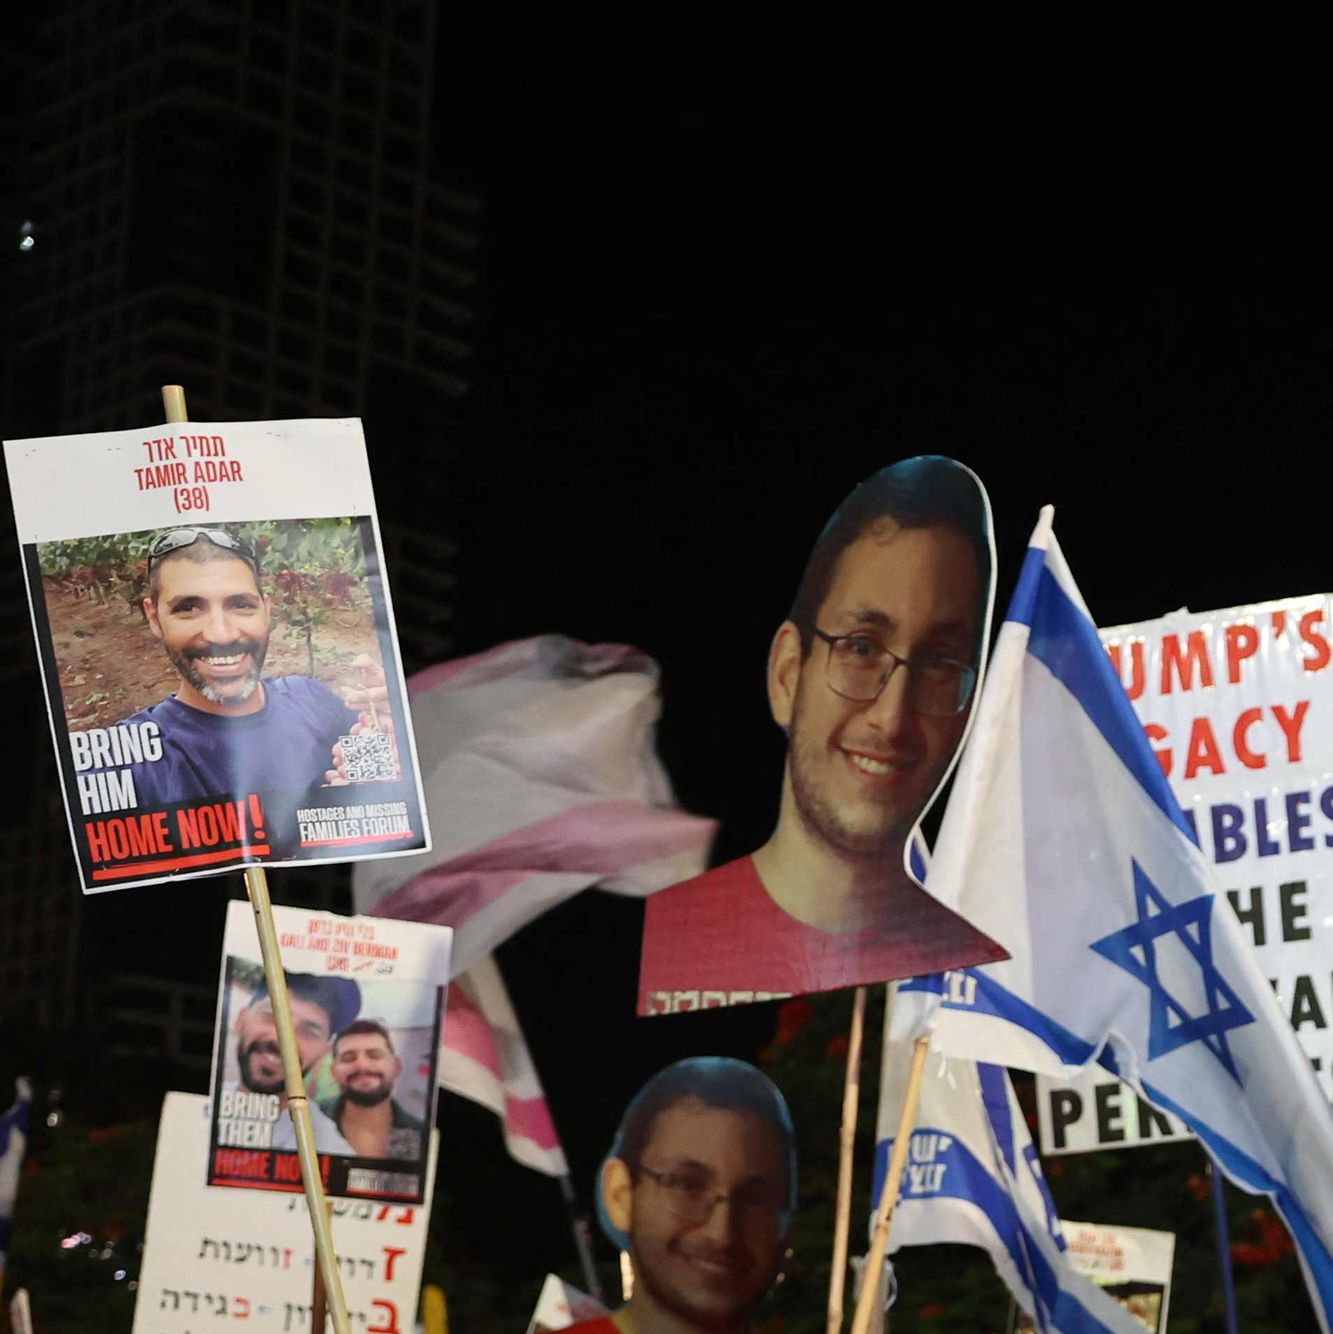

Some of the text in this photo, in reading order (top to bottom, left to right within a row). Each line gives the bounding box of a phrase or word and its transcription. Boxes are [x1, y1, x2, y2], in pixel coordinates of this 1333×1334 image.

[142, 436, 226, 462] תמיר אדר
[134, 461, 243, 490] TAMIR ADAR
[174, 485, 210, 514] (38)
[1108, 609, 1332, 700] UMP'S
[70, 721, 163, 771] BRING
[1144, 700, 1310, 780] GACY
[76, 769, 138, 815] HIM
[85, 794, 266, 863] HOME NOW!
[297, 808, 344, 823] HOSTAGES
[365, 802, 407, 817] MISSING
[299, 814, 410, 841] FAMILIES FORUM
[1228, 880, 1311, 946] HE
[221, 1090, 280, 1122] BRING
[1050, 1084, 1190, 1148] PER
[218, 1119, 273, 1148] THEM
[215, 1150, 268, 1178] HOME
[276, 1152, 331, 1187] NO!
